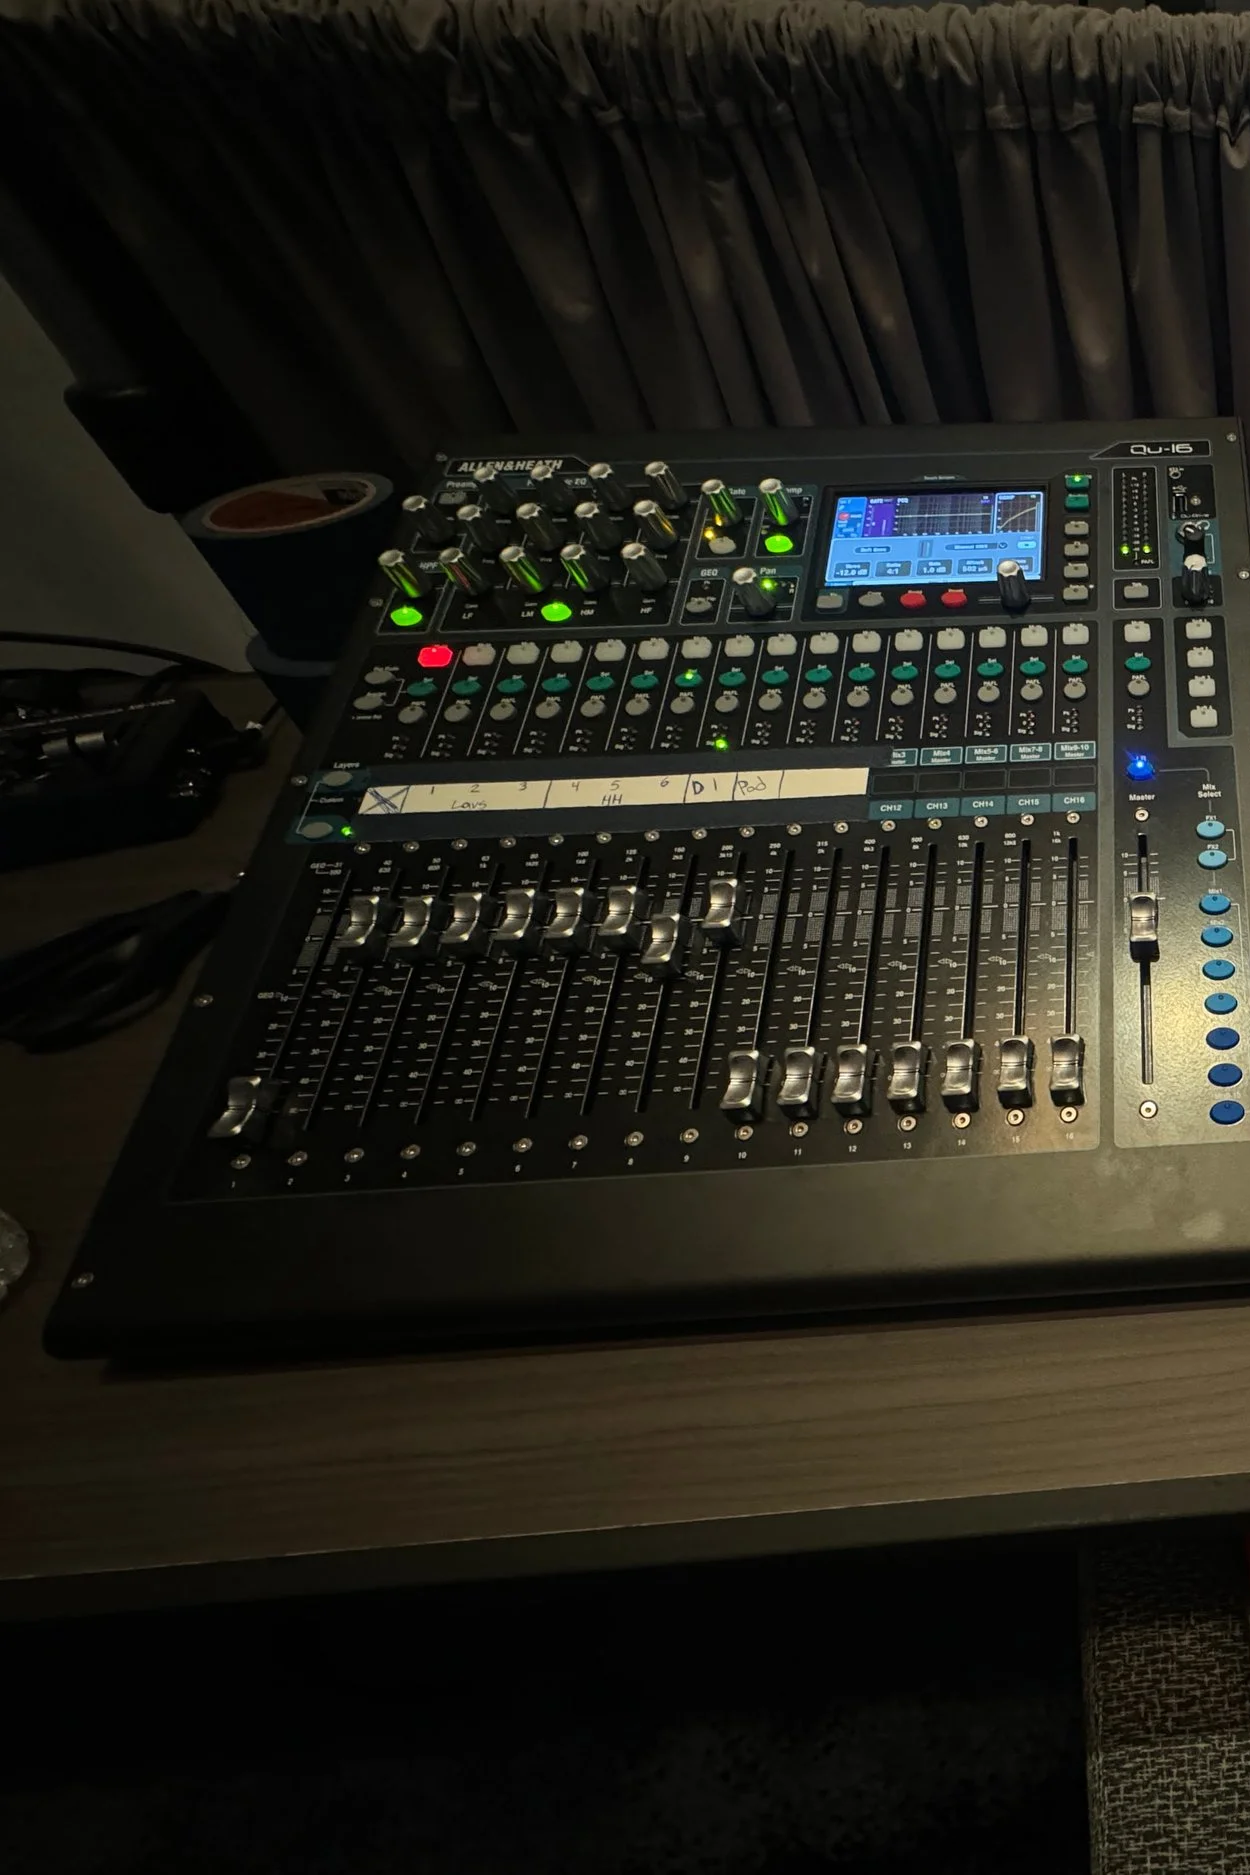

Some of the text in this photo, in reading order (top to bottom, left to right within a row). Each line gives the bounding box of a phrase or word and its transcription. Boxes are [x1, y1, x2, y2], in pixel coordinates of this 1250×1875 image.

[1130, 443, 1194, 456] Qu-16
[333, 761, 360, 769] Layers
[430, 786, 434, 794] 1
[470, 784, 480, 793] 2
[518, 782, 527, 791] 3
[572, 781, 580, 791] 4
[610, 780, 620, 791] 5
[660, 778, 669, 788] 6
[692, 781, 704, 795] D
[737, 776, 767, 796] Pod
[1128, 794, 1155, 802] Master
[1197, 790, 1222, 798] Select
[451, 794, 622, 810] Lavs HH
[972, 800, 994, 808] CH14
[1018, 798, 1039, 806] CH15
[1064, 796, 1085, 804] CH16
[880, 804, 902, 812] CH12
[926, 802, 948, 810] CH13
[848, 1144, 857, 1153] 12
[903, 1141, 912, 1150] 13
[738, 1151, 747, 1159] 10
[793, 1148, 802, 1156] 11
[683, 1154, 689, 1162] 9
[572, 1160, 578, 1168] 7
[514, 1164, 521, 1173] 6
